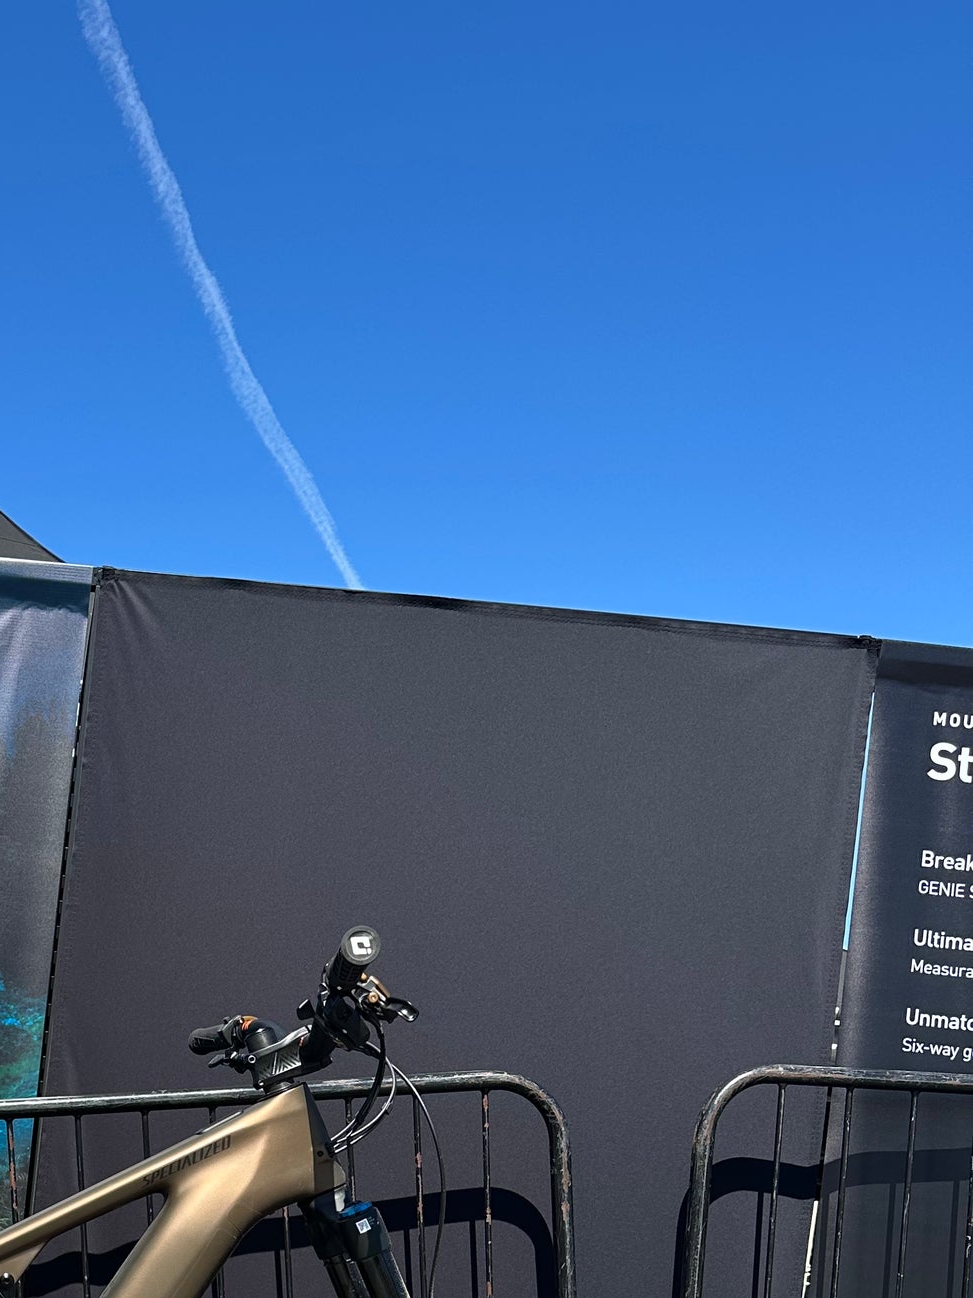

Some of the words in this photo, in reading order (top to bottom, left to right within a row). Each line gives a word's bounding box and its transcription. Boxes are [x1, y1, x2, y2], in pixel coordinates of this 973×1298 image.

[927, 742, 973, 784] St
[918, 880, 966, 898] GENIE
[913, 929, 973, 951] Ultima
[910, 958, 973, 979] Measura
[902, 1037, 960, 1060] Six-way
[963, 1047, 973, 1061] g
[142, 1134, 232, 1188] SPECIALIZED
